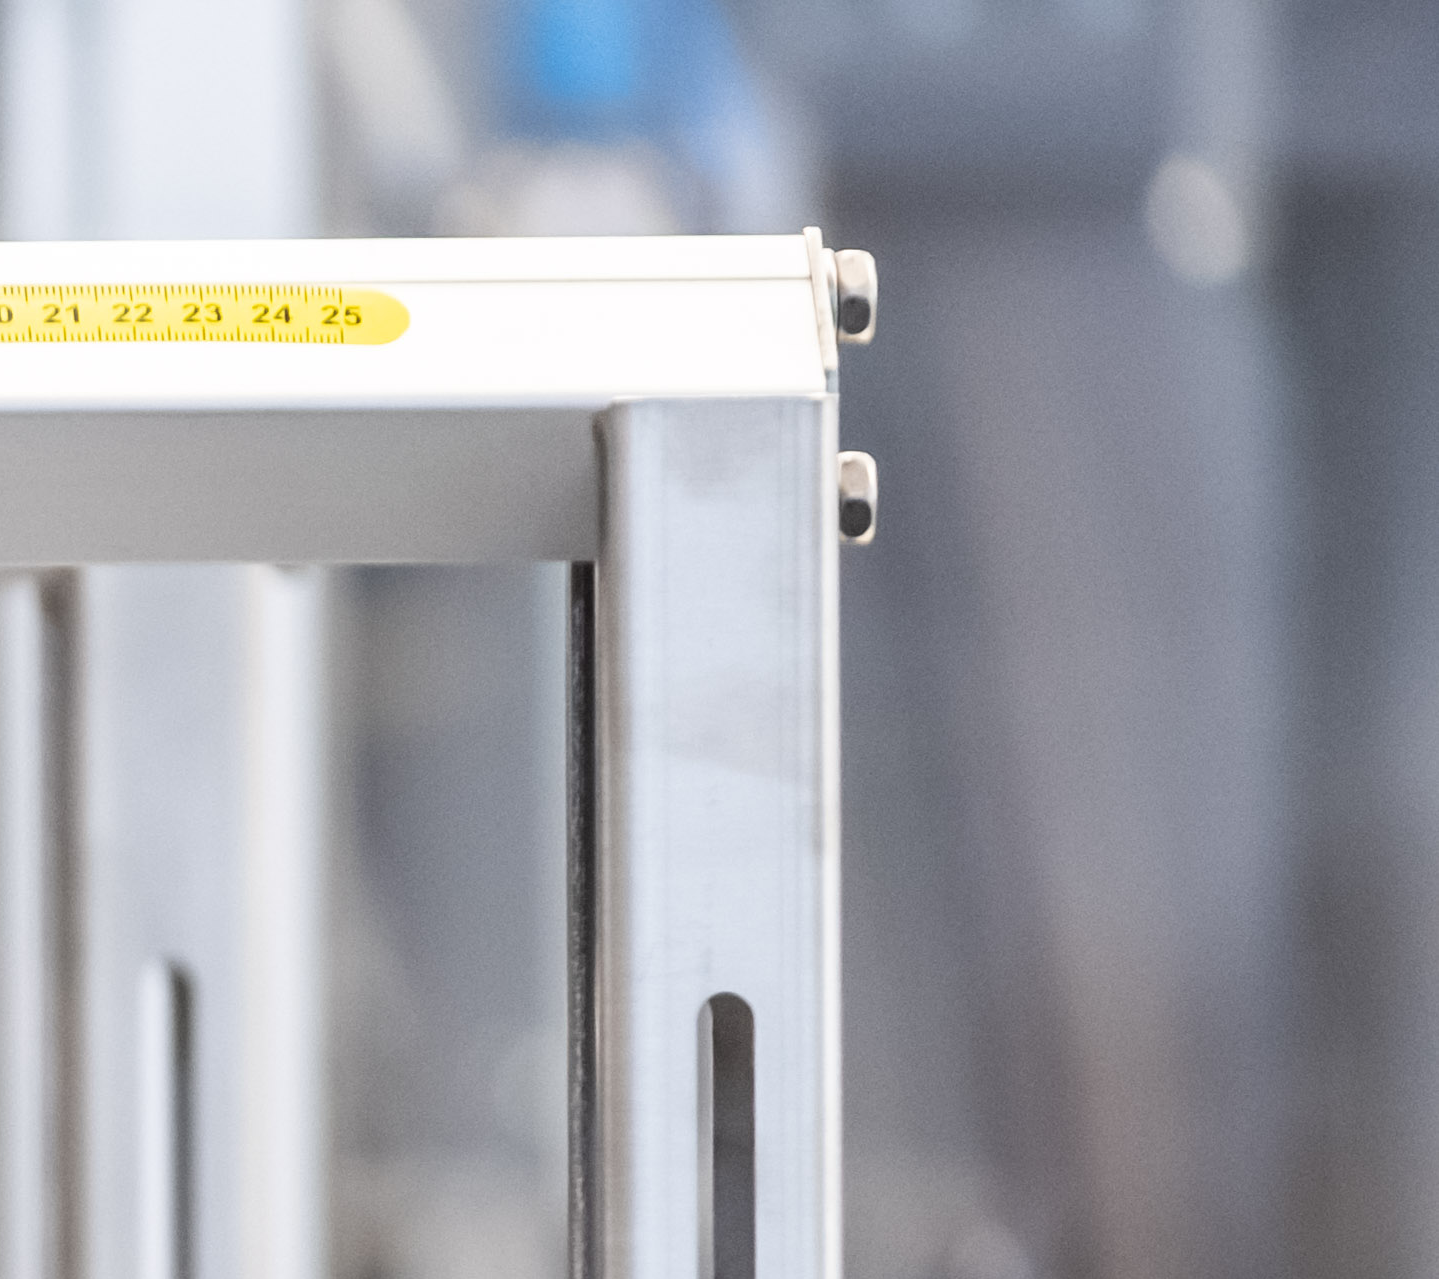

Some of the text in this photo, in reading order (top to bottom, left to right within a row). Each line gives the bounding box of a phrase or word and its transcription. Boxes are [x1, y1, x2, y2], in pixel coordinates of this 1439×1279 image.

[42, 304, 80, 324] 21
[112, 303, 154, 323] 22
[182, 303, 223, 323] 23
[251, 304, 292, 325] 24
[320, 304, 363, 327] 25
